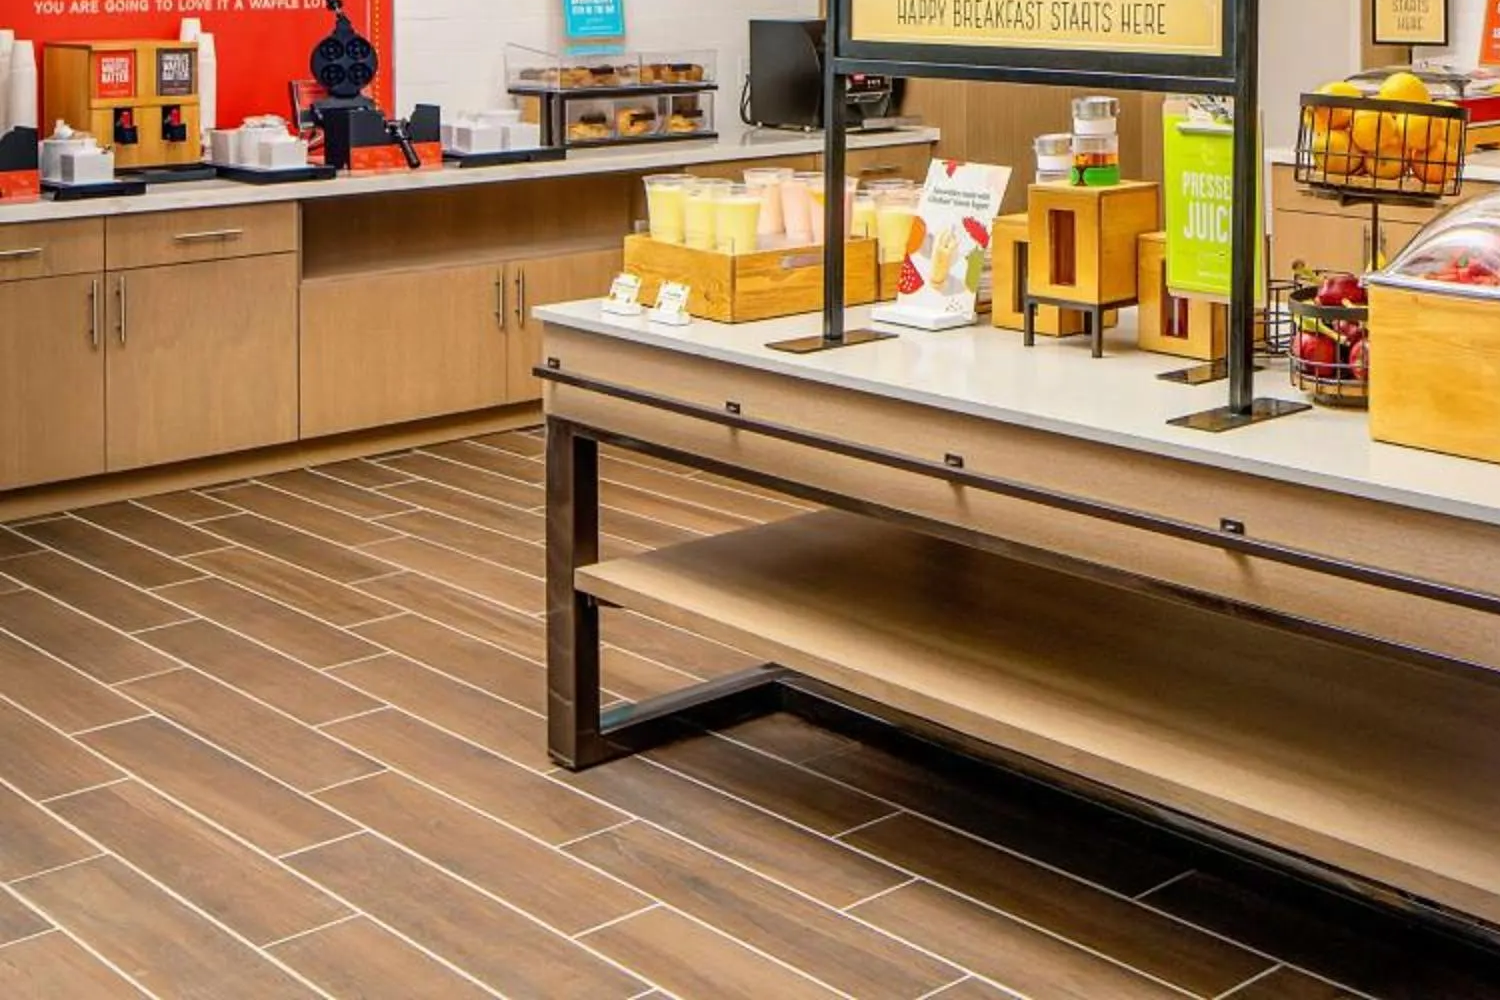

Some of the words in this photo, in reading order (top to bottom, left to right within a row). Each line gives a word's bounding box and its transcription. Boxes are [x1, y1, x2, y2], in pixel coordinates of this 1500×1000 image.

[34, 0, 64, 15] YOU
[69, 0, 99, 14] ARE
[952, 0, 1044, 31] BREAKFAST
[1050, 1, 1113, 34] STARTS
[1121, 3, 1167, 36] HERE
[1182, 171, 1233, 200] PRESSE
[1183, 202, 1232, 243] JUIC
